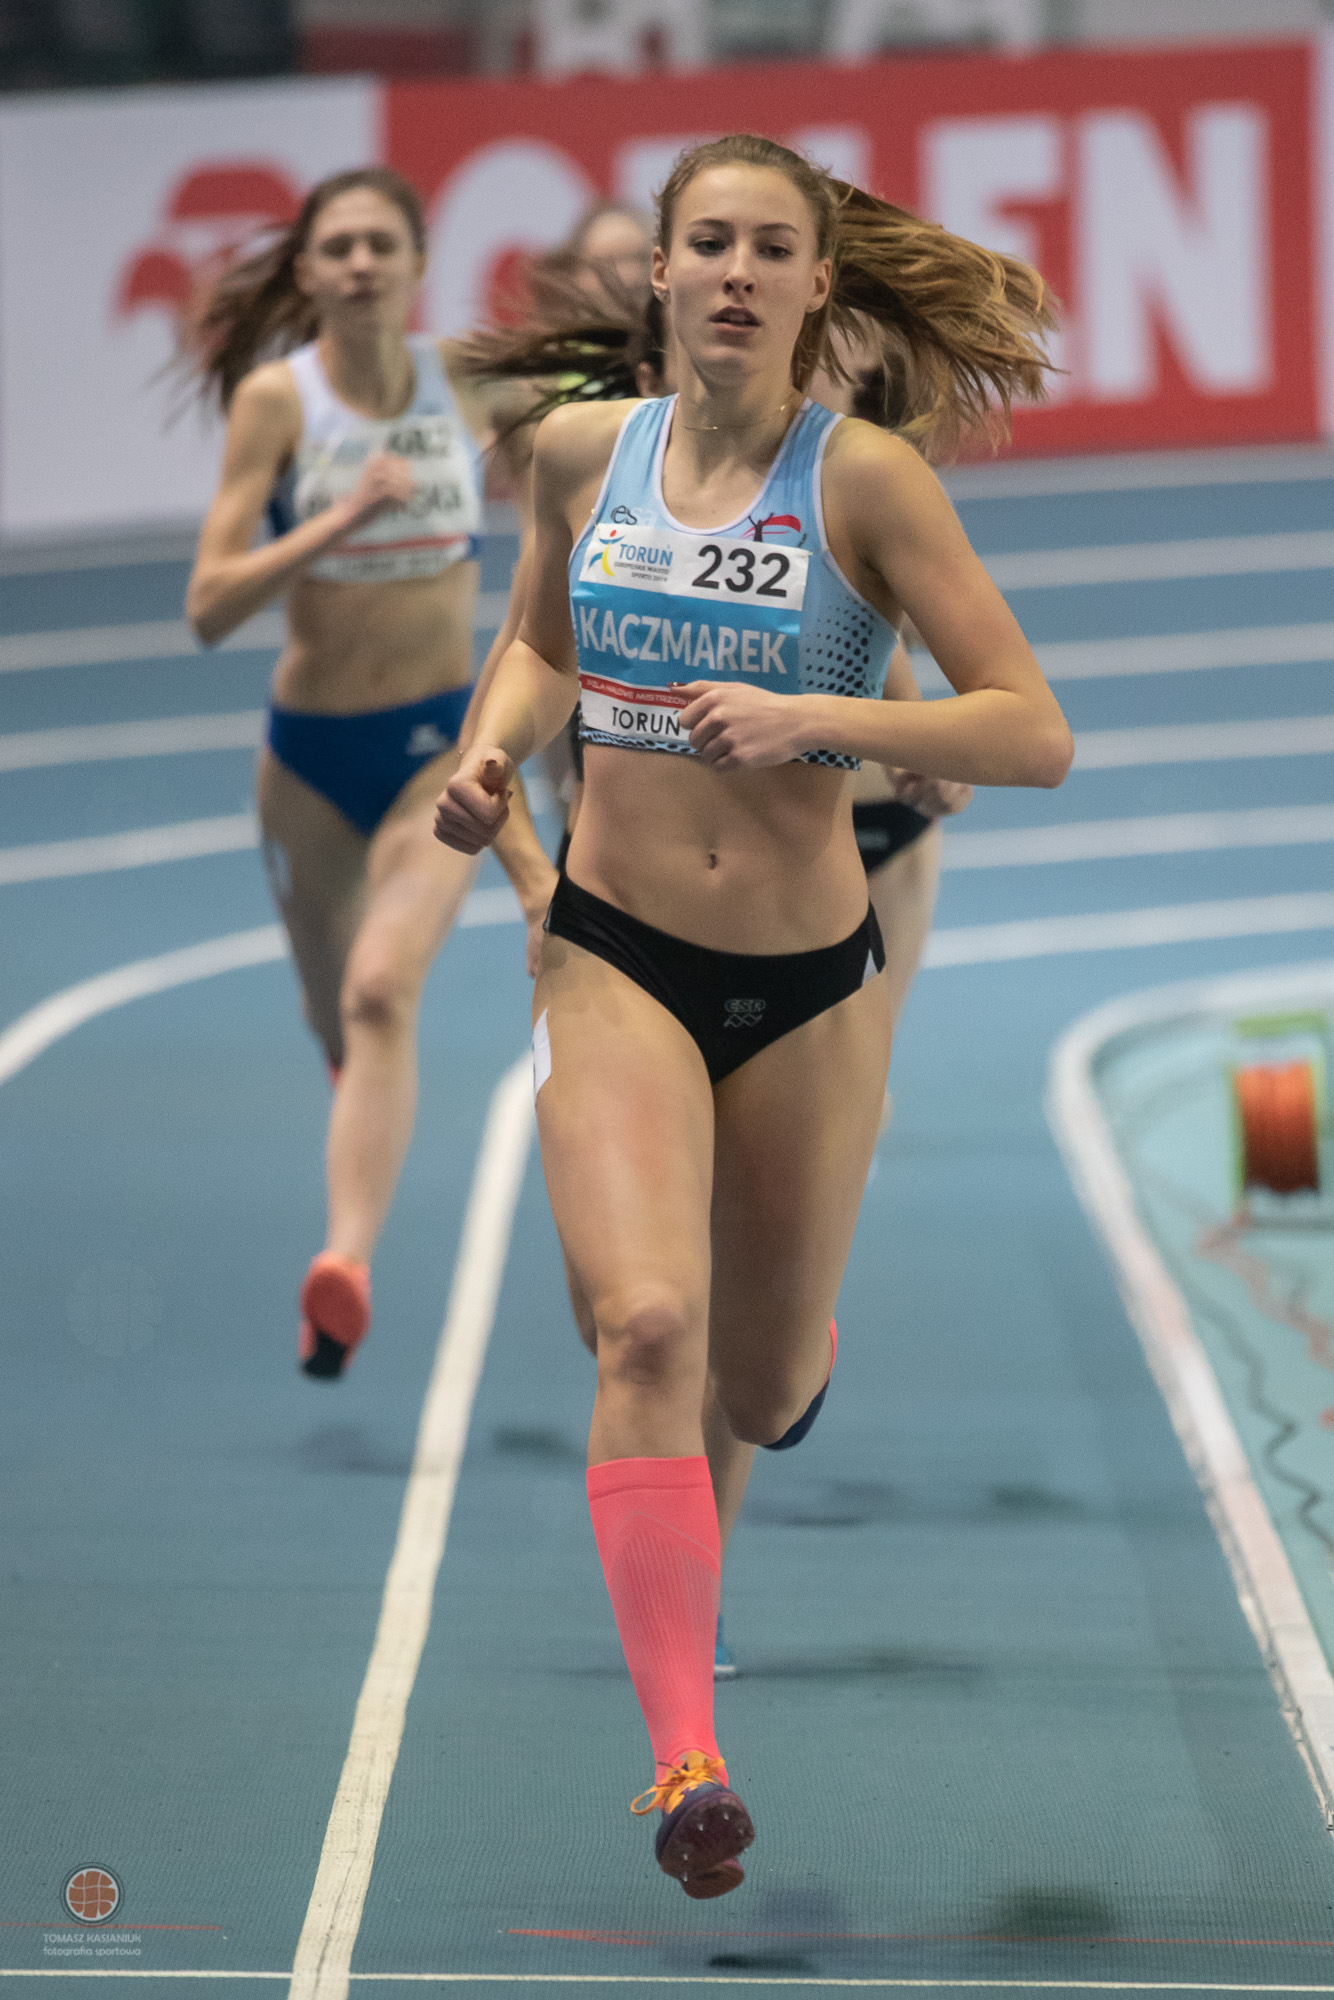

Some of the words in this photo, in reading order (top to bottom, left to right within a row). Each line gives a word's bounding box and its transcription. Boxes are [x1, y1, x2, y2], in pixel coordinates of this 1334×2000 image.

[424, 102, 1268, 430] OEN
[691, 544, 790, 598] 232
[579, 605, 788, 675] KACZMAREK
[612, 706, 680, 736] TORUŃ
